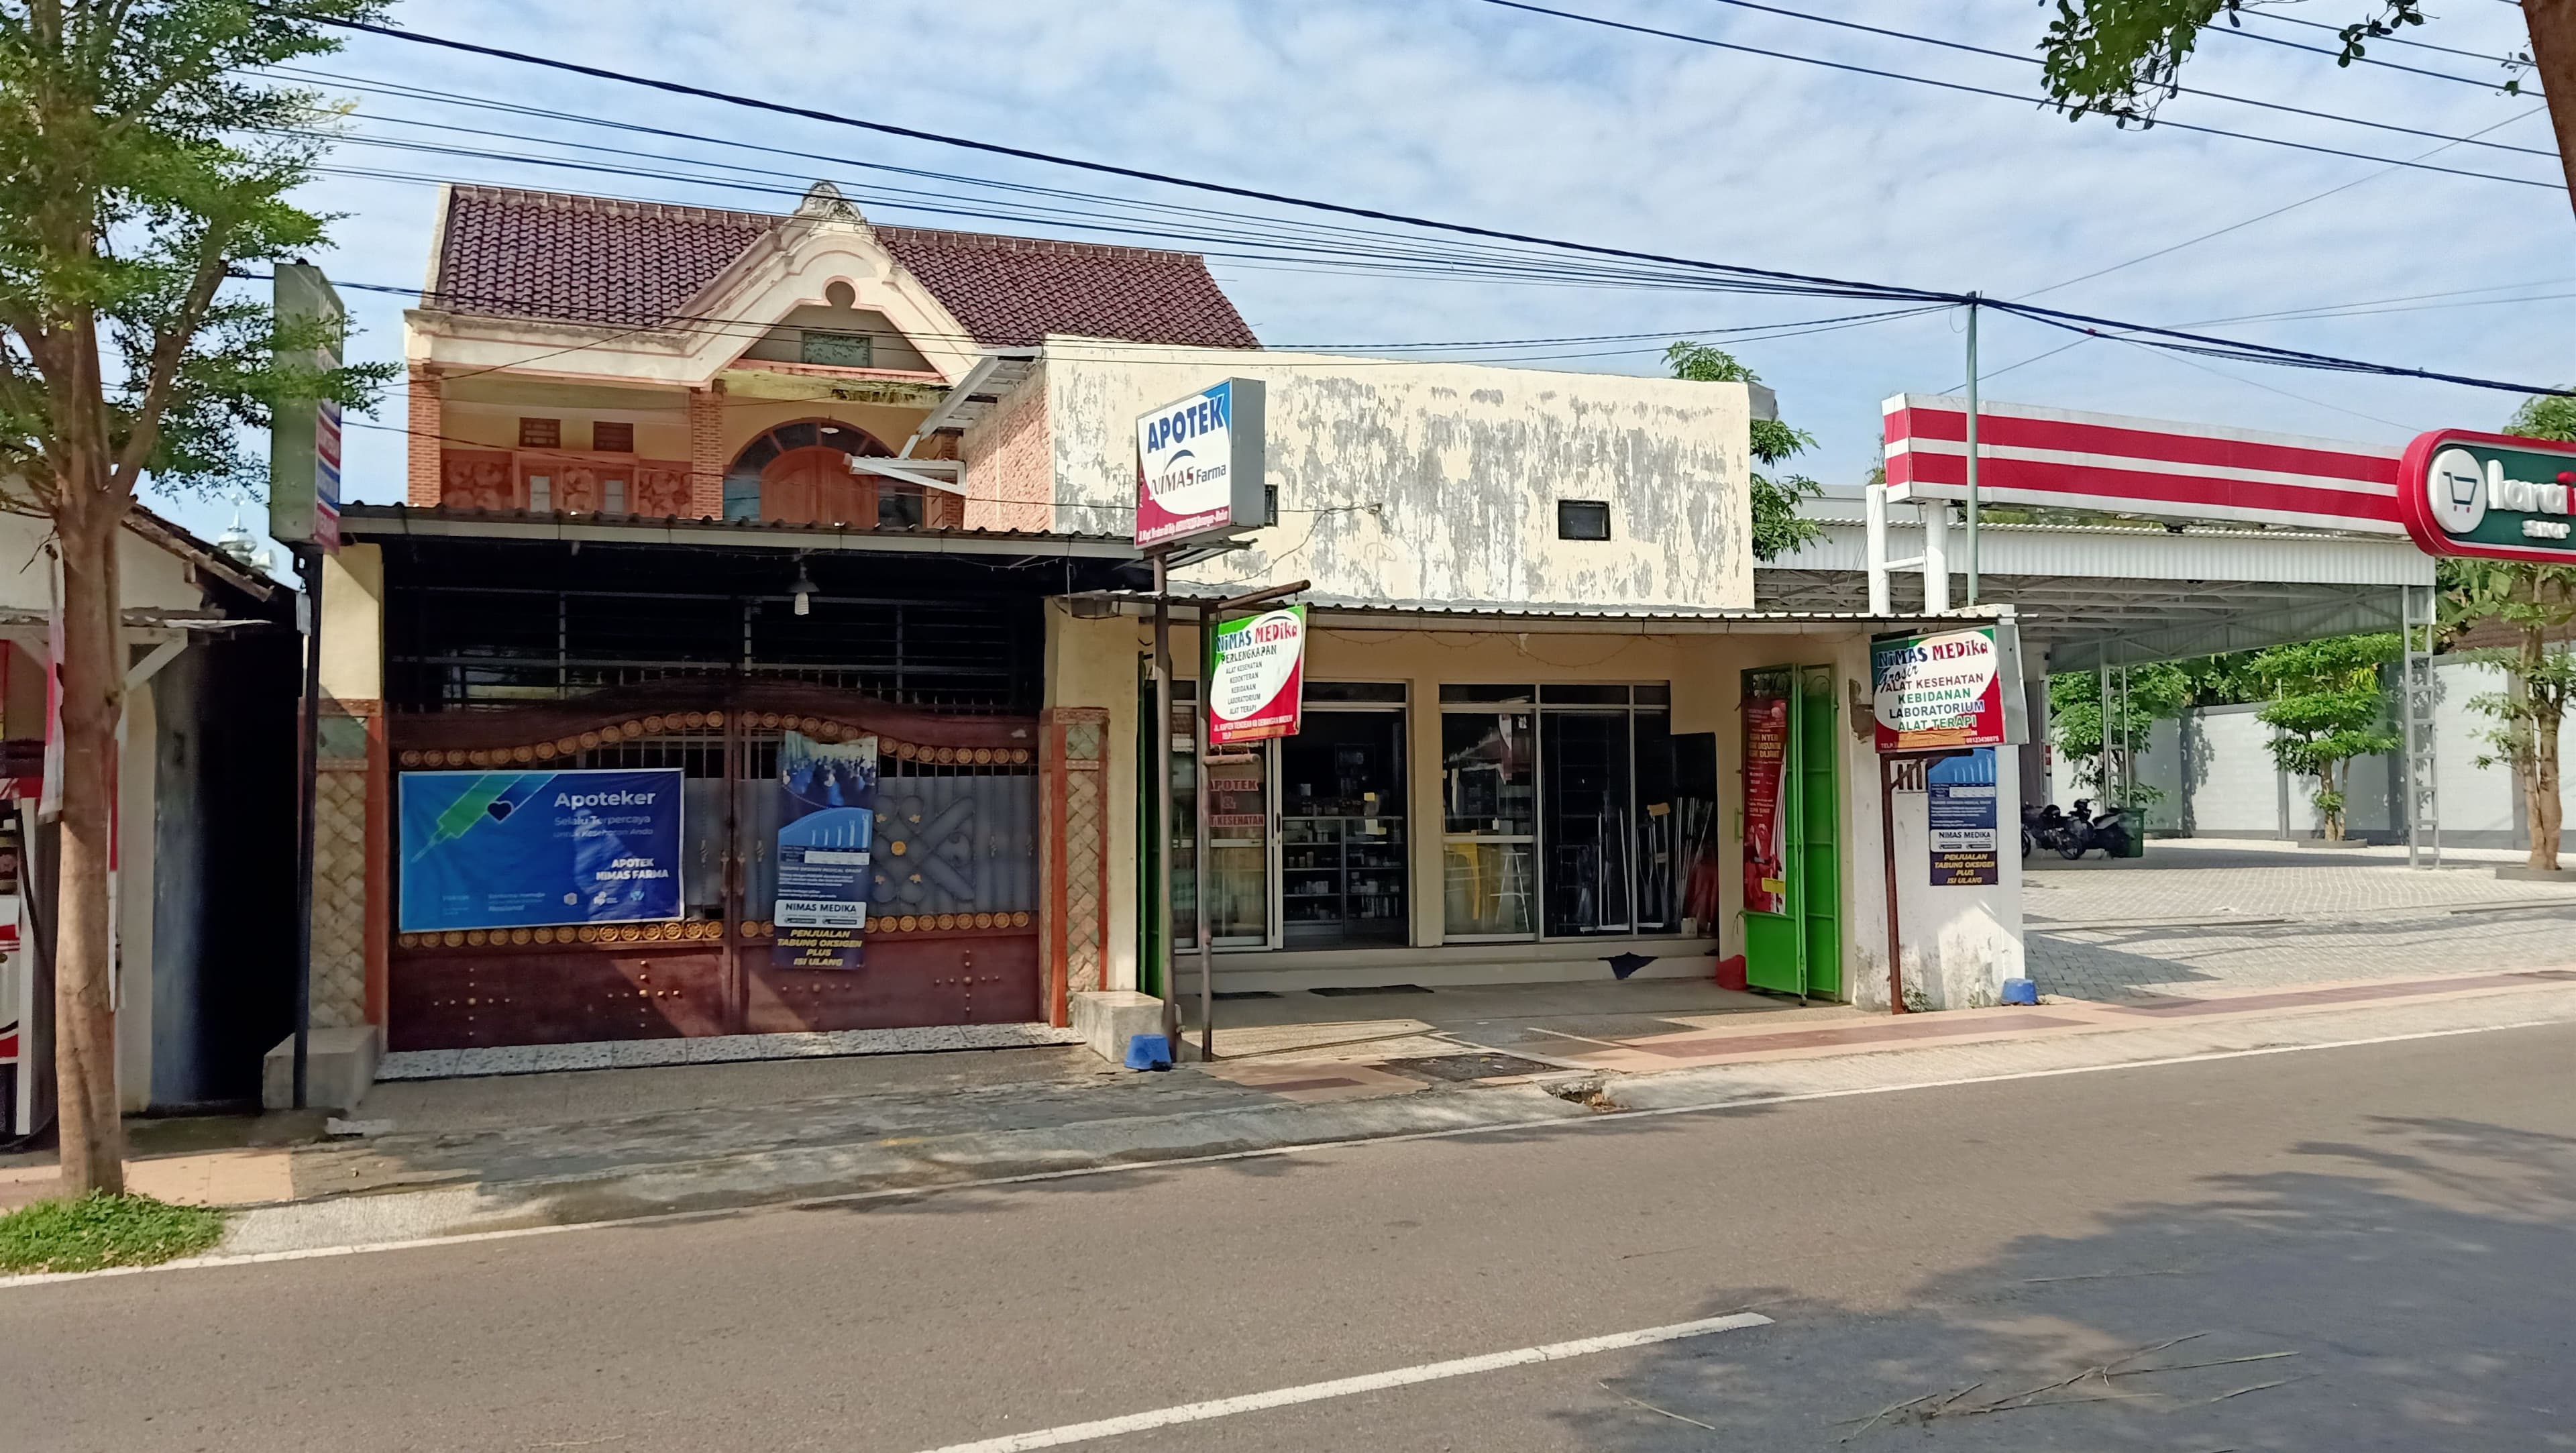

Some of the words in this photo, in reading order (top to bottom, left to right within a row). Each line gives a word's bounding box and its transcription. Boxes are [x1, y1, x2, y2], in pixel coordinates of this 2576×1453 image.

[1148, 394, 1224, 454] APOTEK
[1151, 466, 1194, 498] NIMAS
[1196, 464, 1226, 484] Farma
[1221, 645, 1277, 664] PERLENGKAPAN
[1238, 661, 1263, 671] KESEHATAN
[1230, 672, 1259, 684] KEDOKTERAN
[1878, 665, 1919, 694] Grosir
[1886, 680, 1913, 692] ALAT
[1917, 673, 1984, 689] KESEHATAN
[1231, 684, 1256, 694] KEBIDANAN
[1228, 694, 1261, 704] LABORATORIUM
[1898, 688, 1971, 705] KEBIDANAN
[1240, 705, 1256, 713] TERAPI
[1889, 701, 1984, 719] LABORATORIUM
[1898, 720, 1928, 731] ALAT
[1931, 716, 1976, 728] TERAPI
[554, 790, 657, 810] Apoteker
[555, 816, 588, 826] Selalu
[590, 815, 651, 825] Terpercaya
[1217, 815, 1264, 826] KESEHATAN
[611, 858, 655, 868] APOTEK
[596, 871, 631, 881] NIMAS
[632, 869, 669, 879] FARMA
[786, 903, 816, 912] NIMAS
[820, 904, 857, 912] MEDIKA
[790, 929, 851, 938] PENJUALAN
[777, 938, 818, 947] TABUNG
[806, 949, 832, 957] PLUS
[808, 958, 843, 966] ULANG
